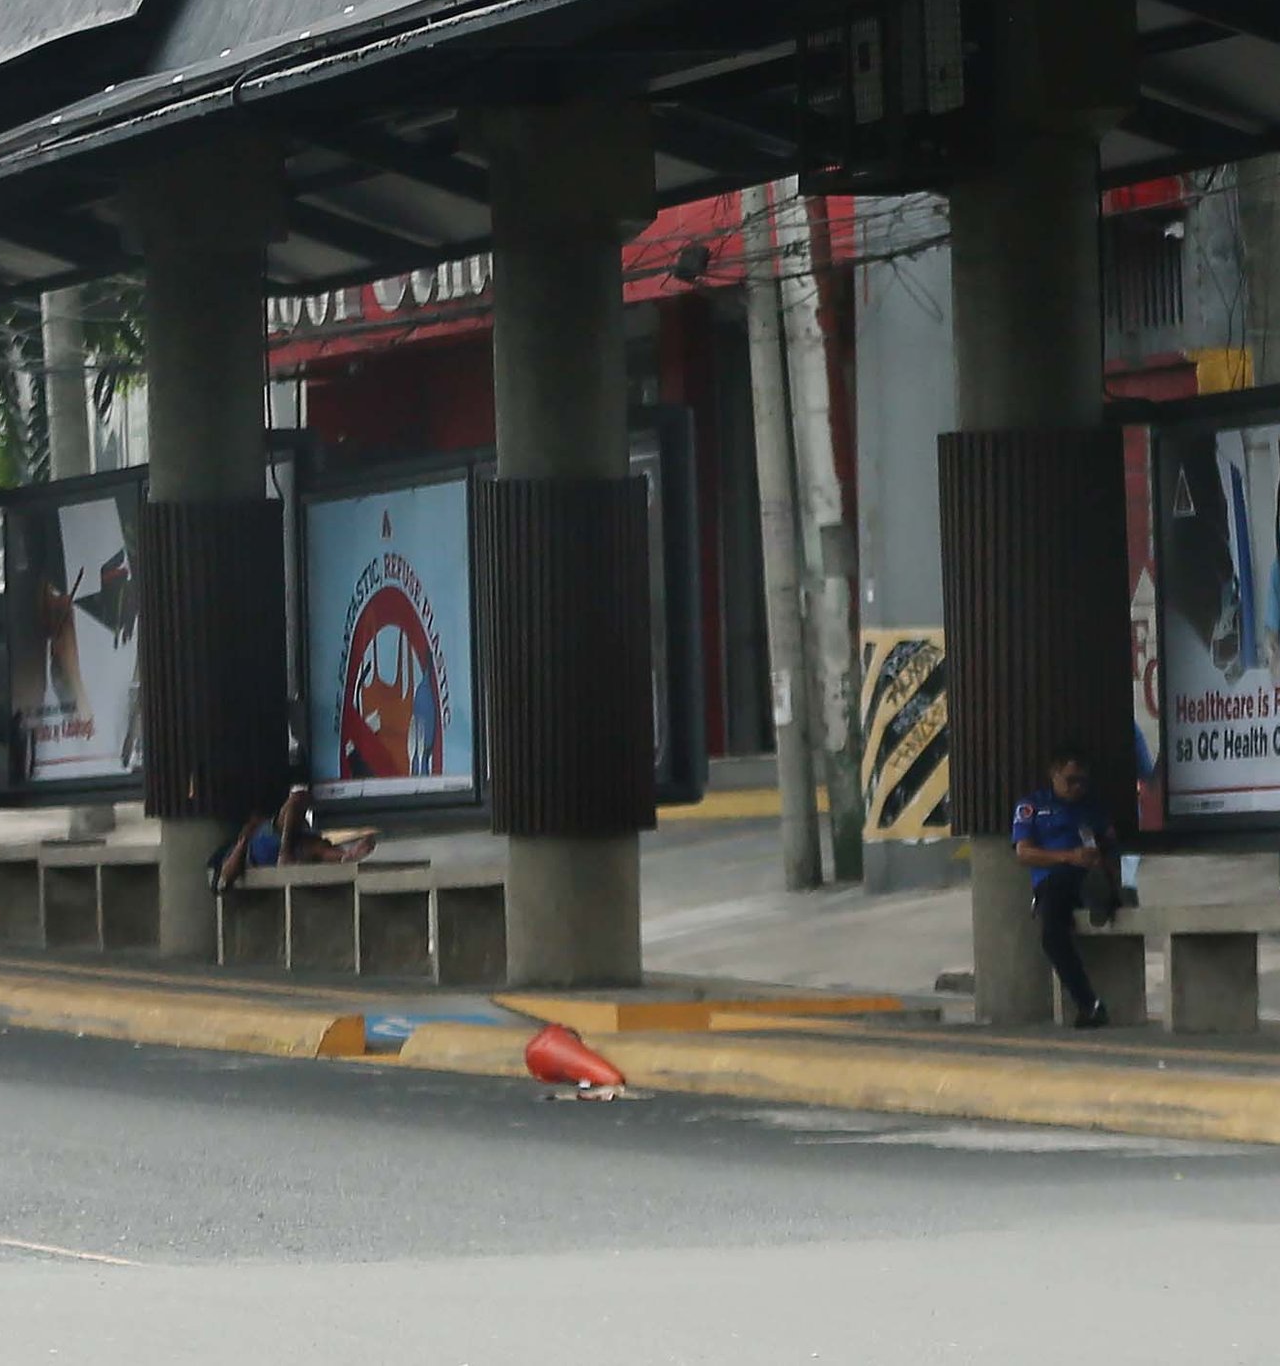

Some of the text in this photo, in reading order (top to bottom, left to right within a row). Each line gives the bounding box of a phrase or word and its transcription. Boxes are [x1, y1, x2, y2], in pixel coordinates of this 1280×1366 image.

[1176, 690, 1254, 724] Healthcare
[1258, 687, 1269, 718] is
[1176, 736, 1193, 763] sa
[1198, 731, 1220, 762] QC
[1223, 726, 1268, 760] Health
